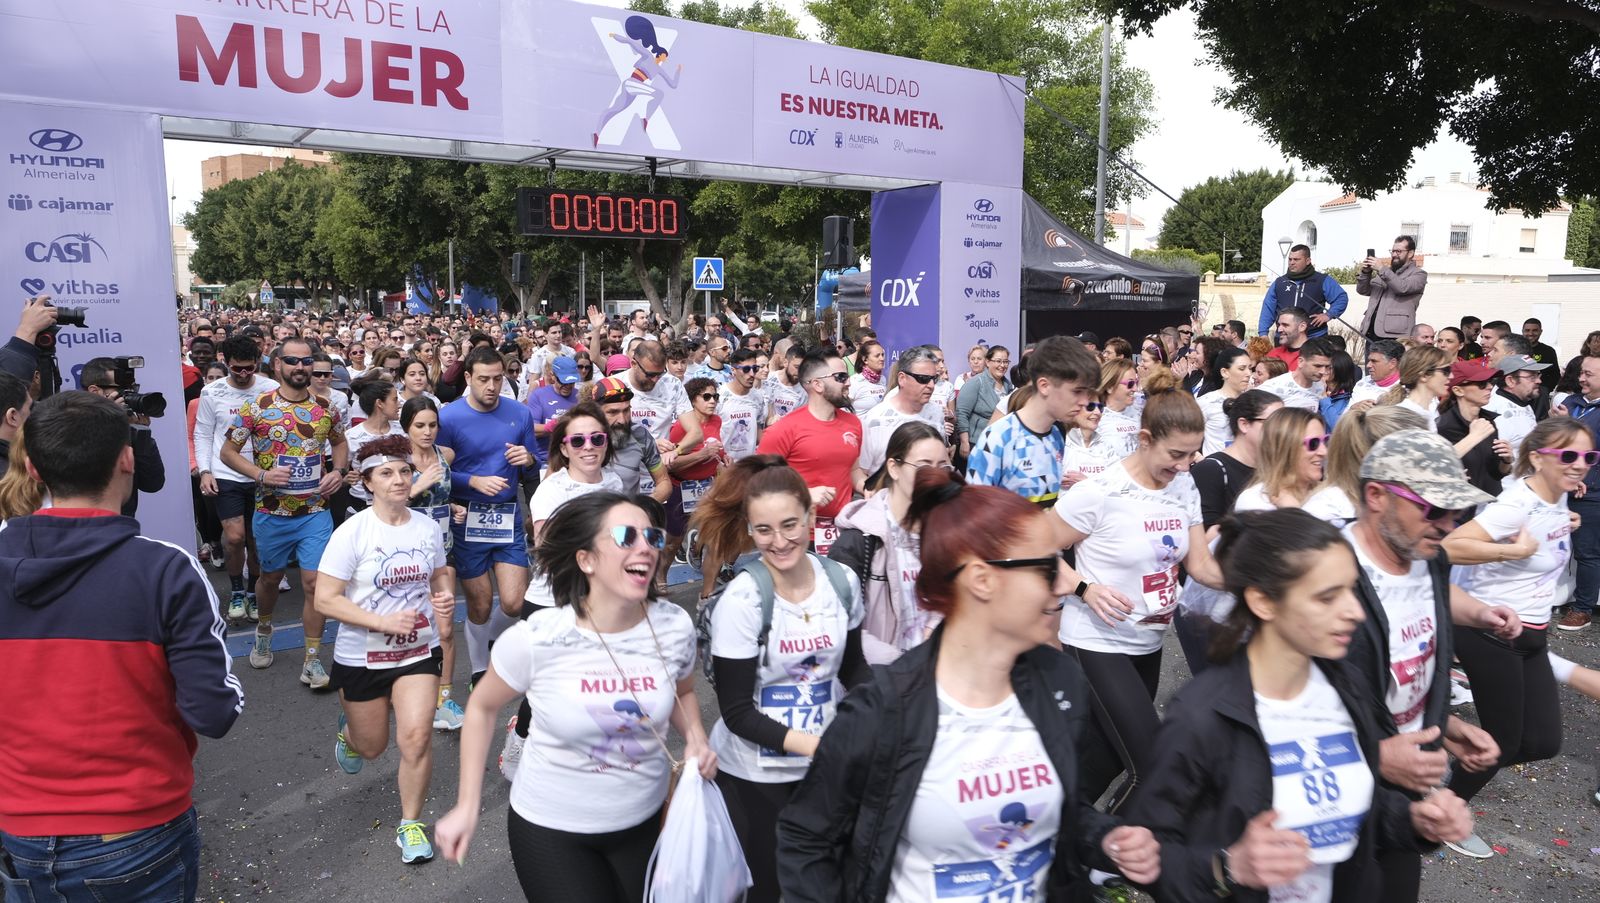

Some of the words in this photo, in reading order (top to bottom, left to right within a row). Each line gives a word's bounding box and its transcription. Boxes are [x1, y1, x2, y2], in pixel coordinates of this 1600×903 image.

[365, 0, 404, 29] DE
[415, 6, 451, 35] LA
[175, 14, 469, 111] MUJER
[809, 64, 831, 85] LA
[836, 69, 920, 98] IGUALDAD
[780, 92, 804, 114] ES
[808, 96, 890, 125] NUESTRA
[894, 107, 944, 131] META.
[9, 153, 105, 169] HYUNDAI
[23, 168, 96, 182] Almerialva
[38, 196, 114, 214] cajamar
[549, 193, 678, 235] 00:00:00
[966, 213, 1001, 222] HYUNDAI
[25, 240, 92, 263] CASI
[974, 239, 1003, 249] cajamar
[967, 264, 992, 279] CASI
[52, 279, 120, 296] vithas
[880, 275, 922, 307] CDX
[975, 288, 1000, 298] vithas
[969, 318, 999, 330] aqualia
[57, 328, 123, 348] qualia
[774, 398, 794, 407] MUJER
[729, 411, 752, 420] MUJER
[290, 467, 313, 478] 299
[478, 513, 503, 525] 248
[1143, 518, 1183, 533] MUJER
[393, 564, 420, 577] MINI
[381, 572, 428, 586] RUNNER
[383, 630, 418, 646] 788
[779, 634, 834, 654] MUJER
[580, 676, 658, 693] MUJER
[782, 705, 824, 729] 174
[958, 763, 1053, 803] MUJER
[1302, 769, 1341, 806] 88
